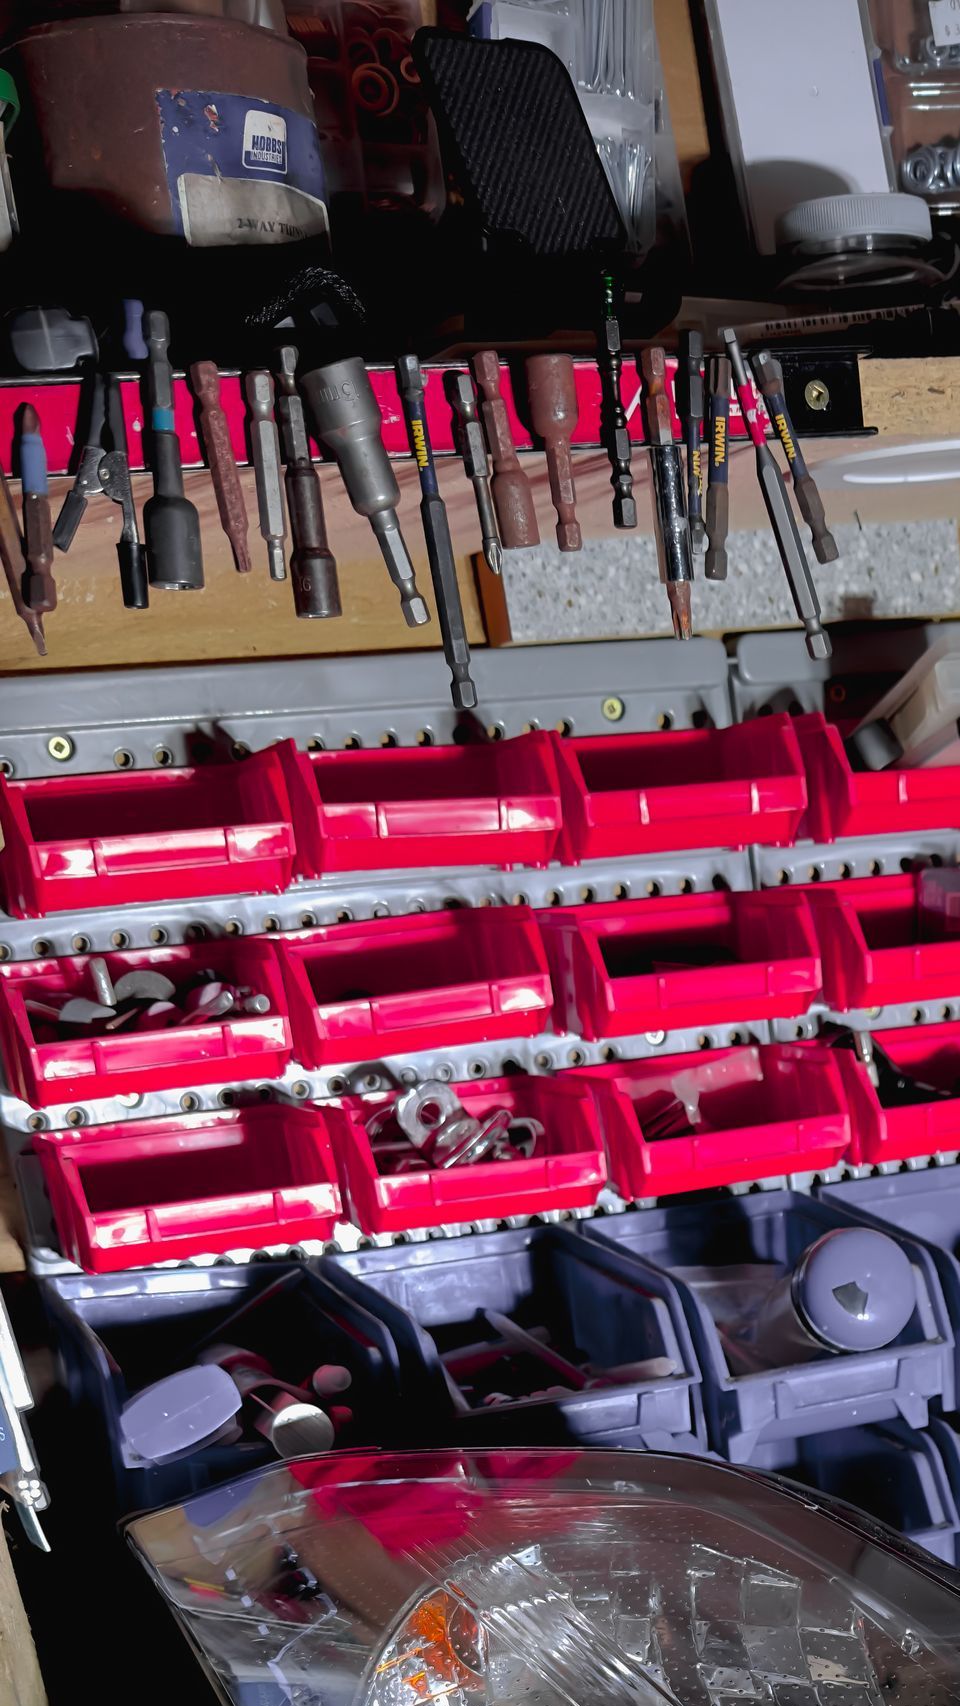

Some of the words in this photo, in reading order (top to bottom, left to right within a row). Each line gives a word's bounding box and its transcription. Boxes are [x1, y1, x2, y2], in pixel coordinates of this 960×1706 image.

[252, 135, 282, 154] HOBBS
[251, 151, 283, 165] INDUSTRIES
[714, 416, 725, 463] IRWIN
